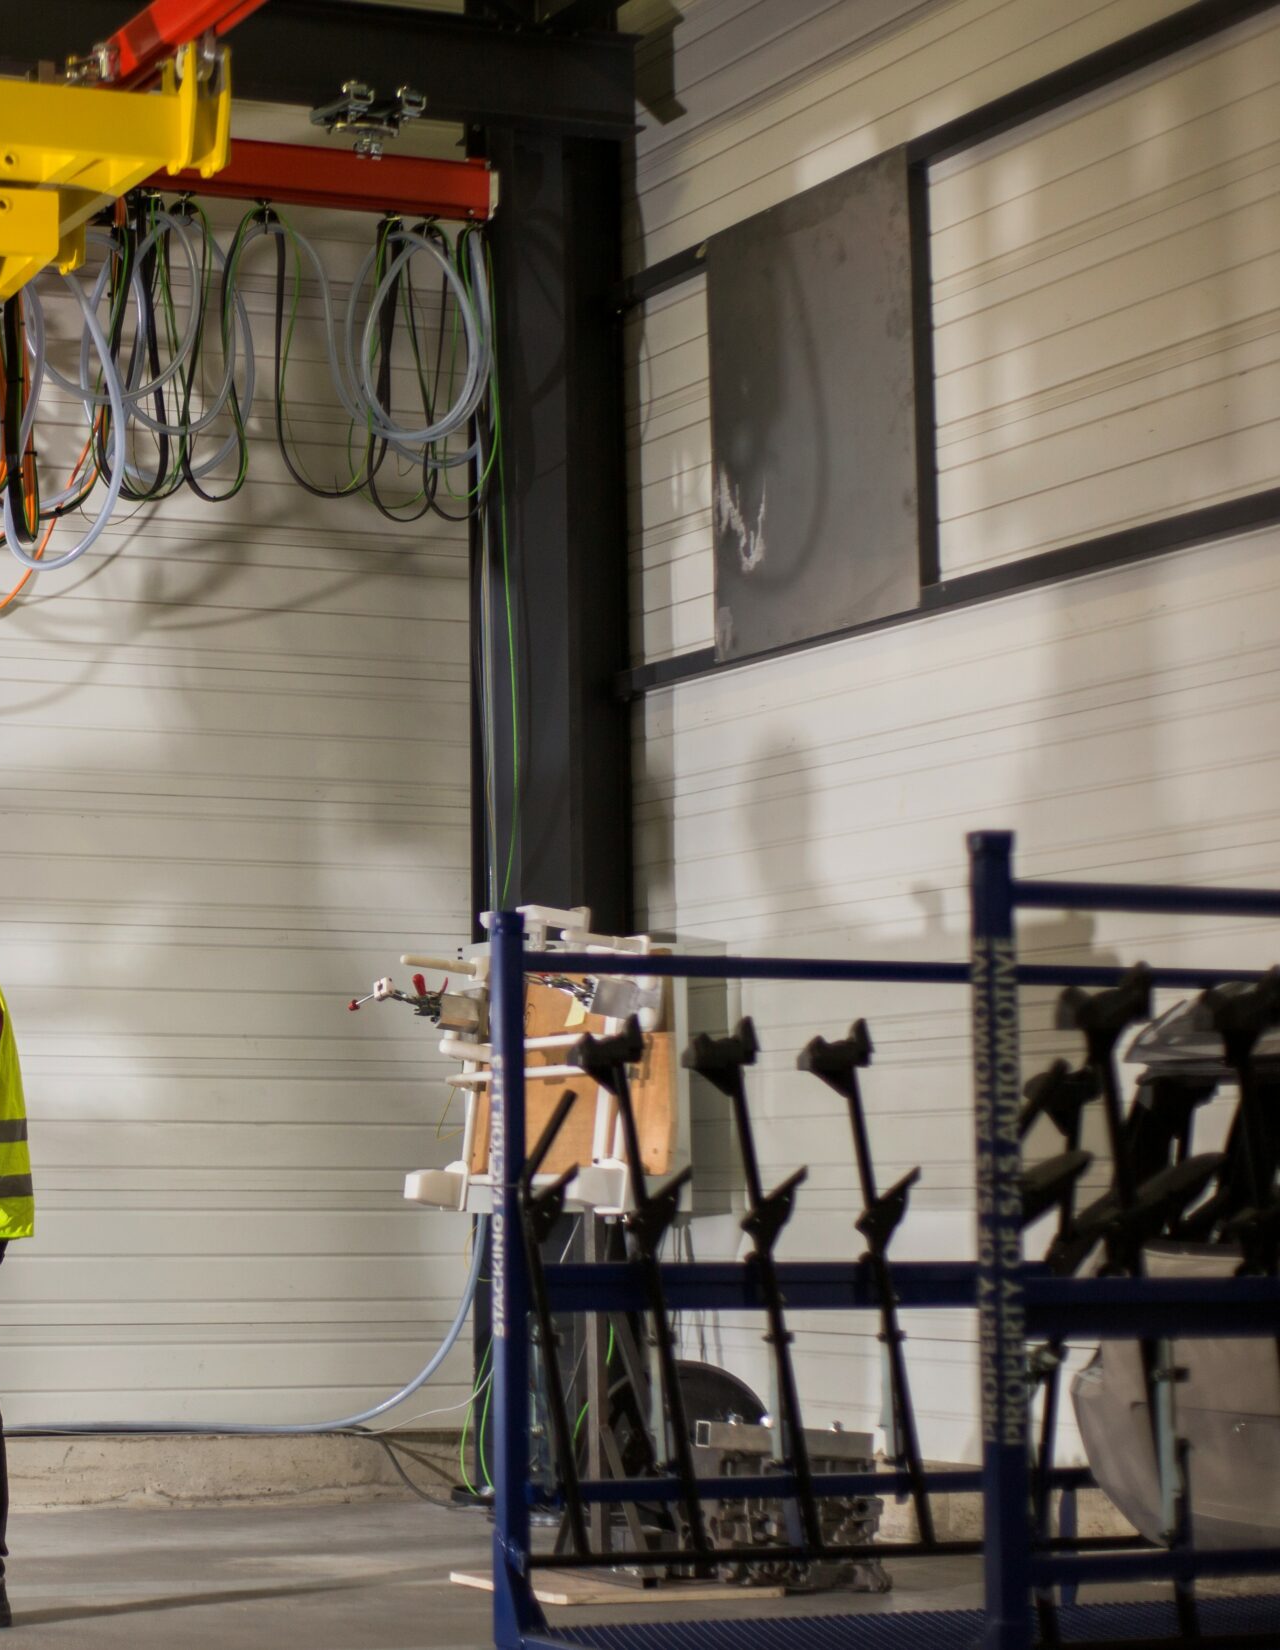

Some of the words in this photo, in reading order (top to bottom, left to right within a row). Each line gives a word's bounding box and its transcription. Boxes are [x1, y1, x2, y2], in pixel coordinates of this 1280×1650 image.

[972, 937, 992, 1142] AUTOMOTIVE
[993, 937, 1019, 1143] AUTOMOTIVE
[492, 1213, 505, 1338] STACKING
[977, 1226, 993, 1267] OF
[998, 1226, 1021, 1269] OF
[979, 1277, 997, 1442] PROPERTY
[1001, 1278, 1025, 1445] PROPERTY
